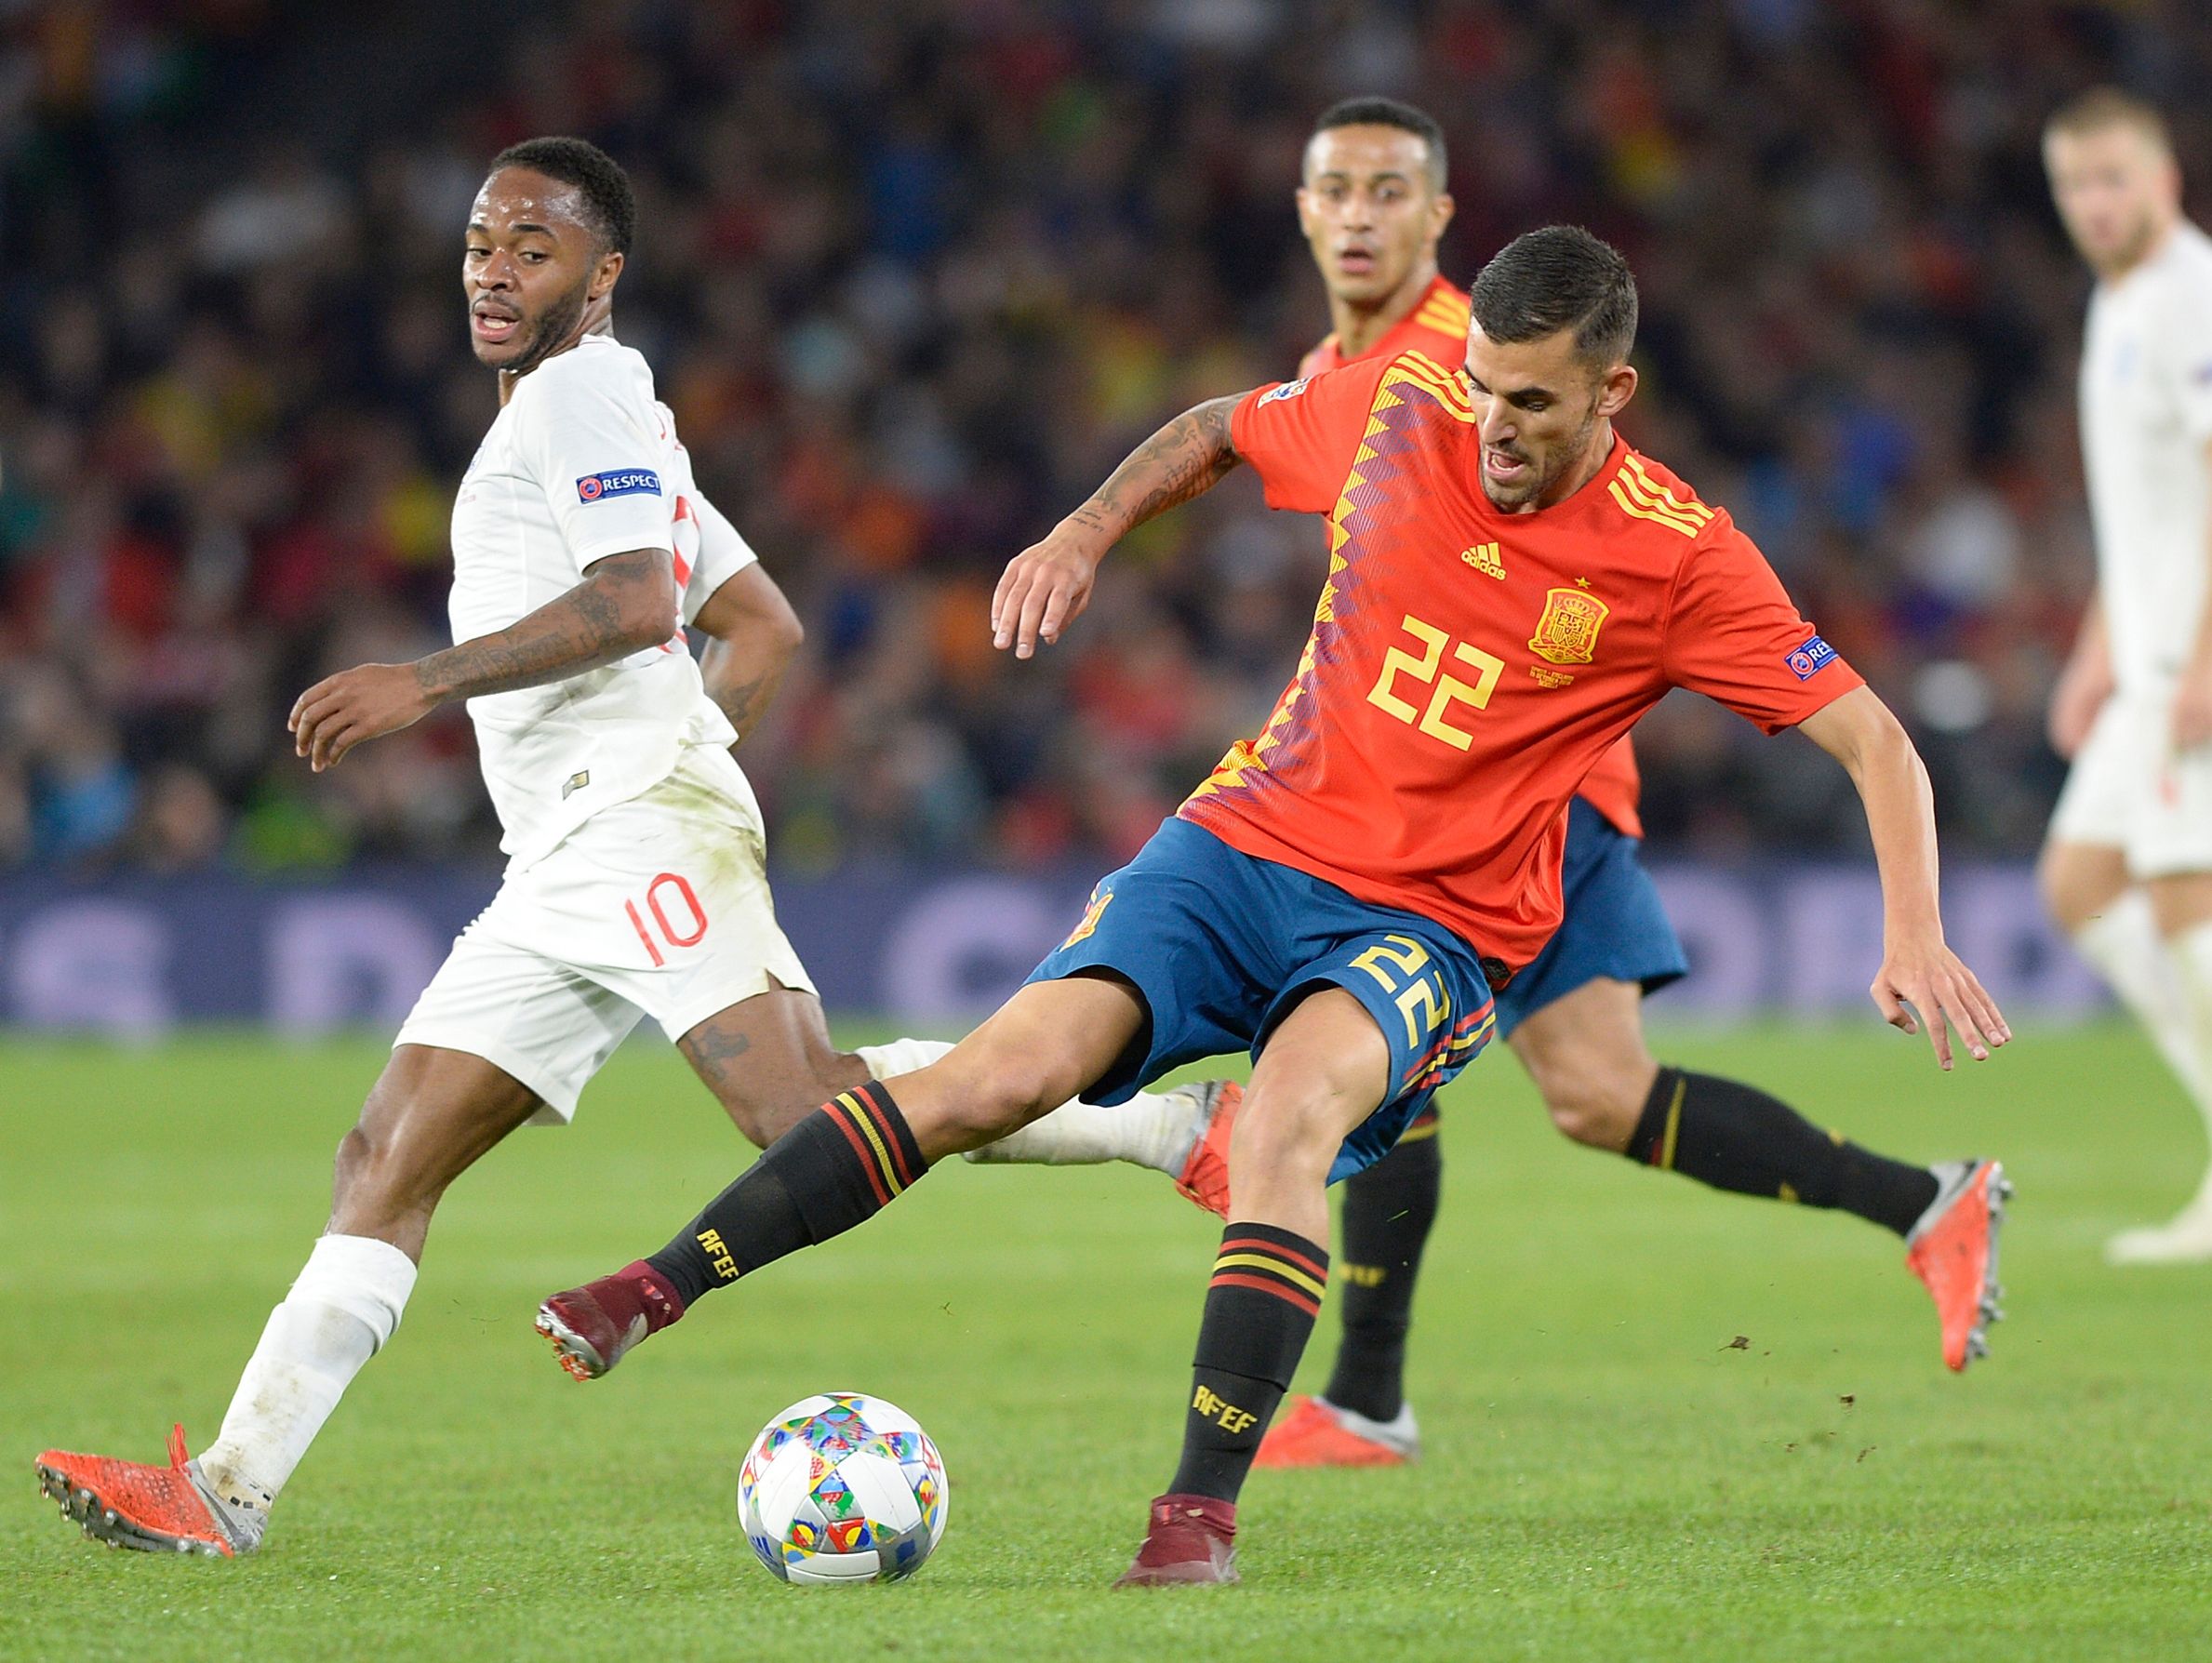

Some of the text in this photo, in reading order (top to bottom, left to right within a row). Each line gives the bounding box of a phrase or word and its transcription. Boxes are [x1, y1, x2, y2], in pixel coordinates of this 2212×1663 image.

[603, 475, 659, 491] RESPECT
[1460, 550, 1507, 581] adidas
[1366, 614, 1506, 752] 22
[625, 872, 708, 967] 10
[1348, 934, 1451, 1050] 22
